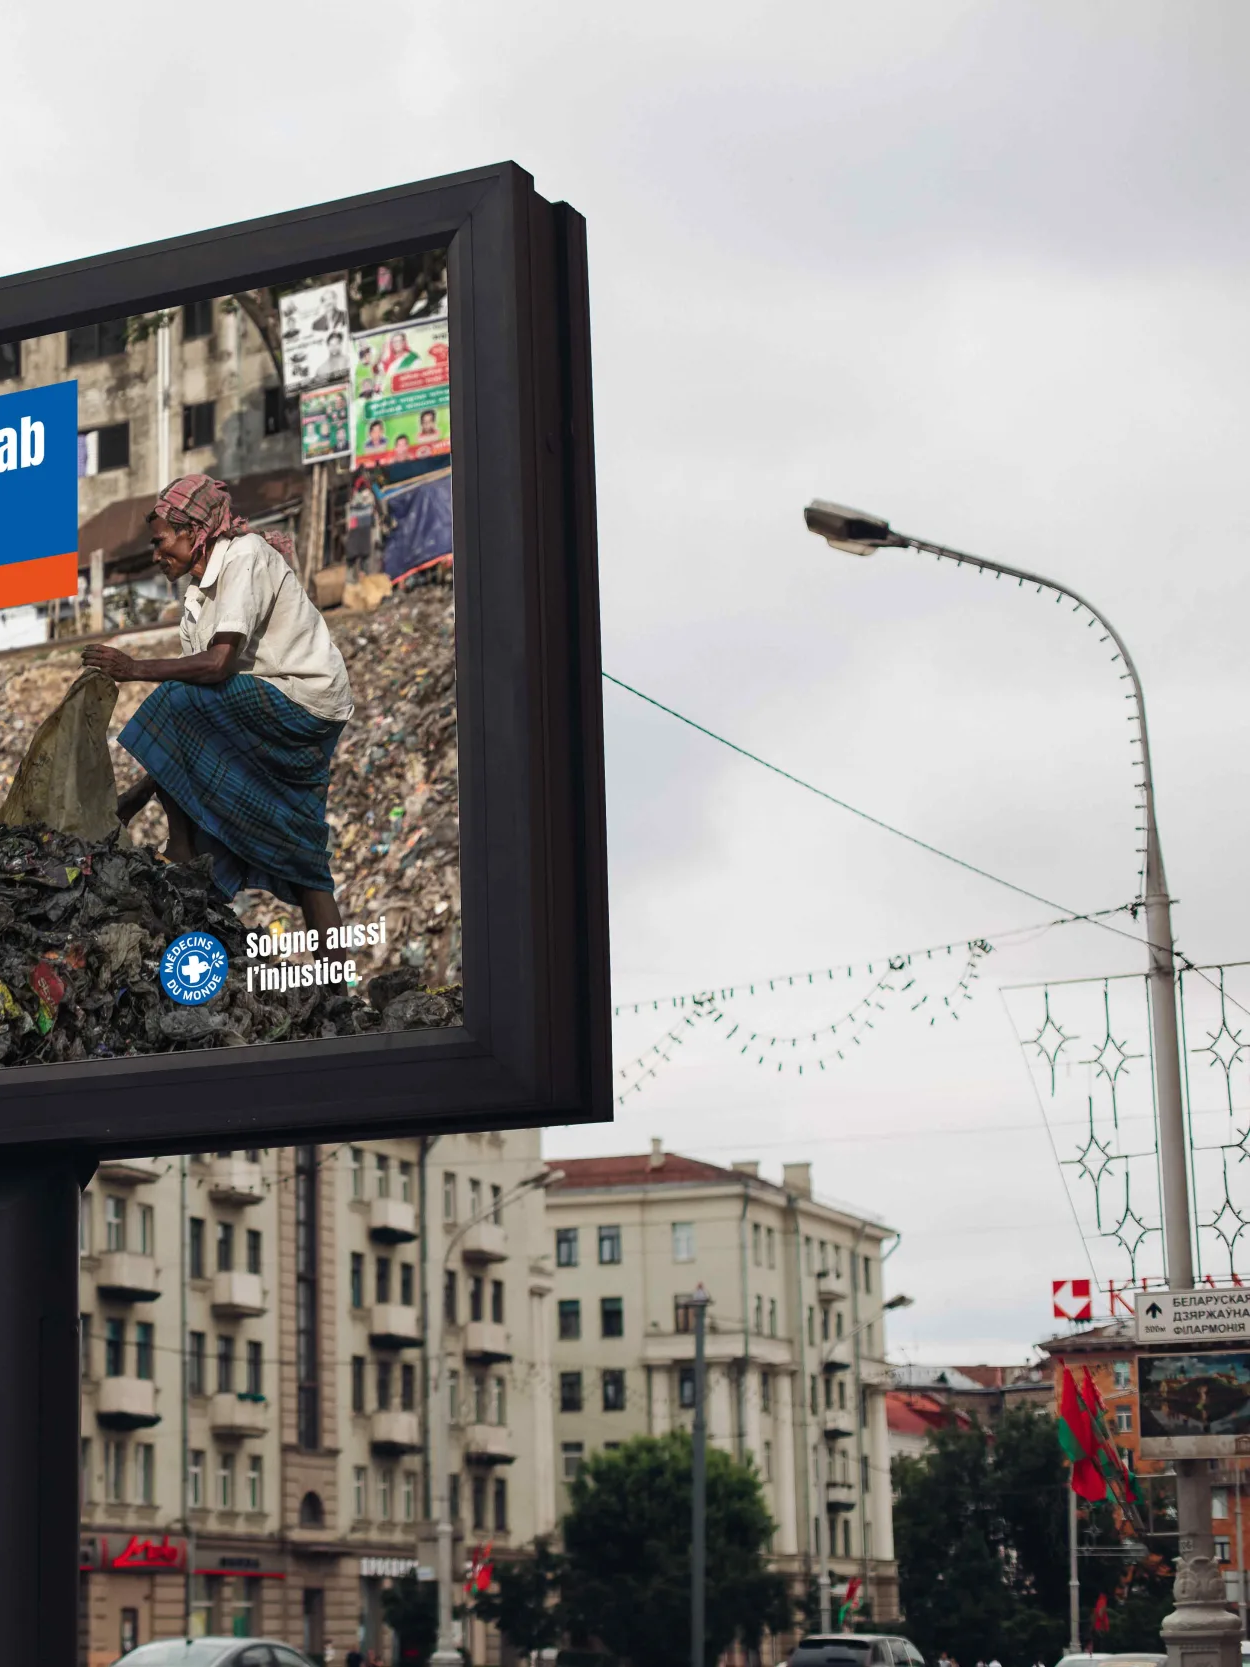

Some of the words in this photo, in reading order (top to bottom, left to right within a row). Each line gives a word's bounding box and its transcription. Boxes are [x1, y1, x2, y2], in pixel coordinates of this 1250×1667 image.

[164, 937, 213, 973] MÉDECINS
[246, 928, 319, 958] Soigne
[326, 916, 386, 950] aussi
[167, 979, 182, 996] DU
[183, 974, 222, 1001] MONDE
[247, 957, 363, 993] l’injustice.
[1173, 1322, 1246, 1335] ФІЛАРМОНІЯ
